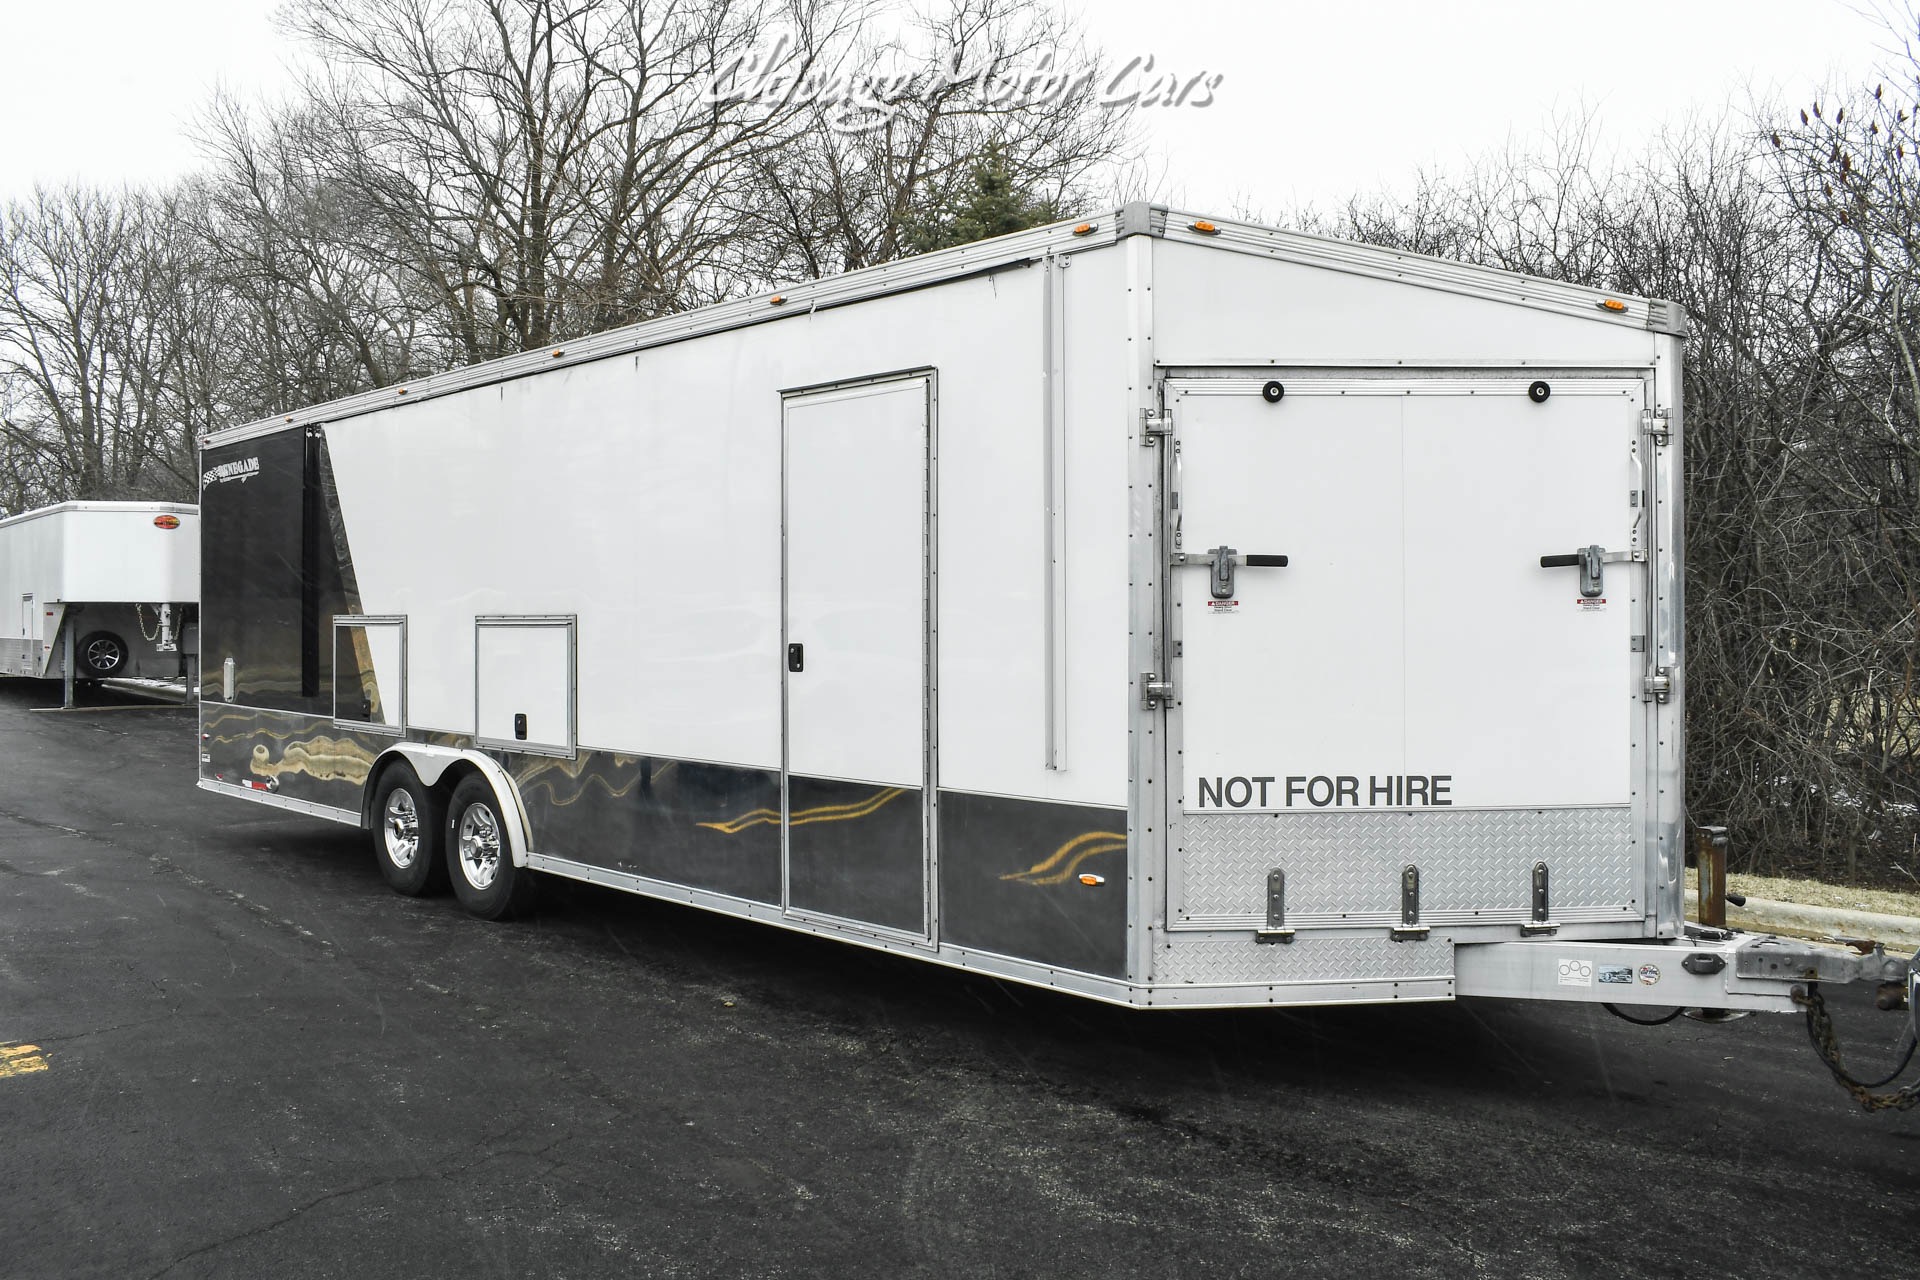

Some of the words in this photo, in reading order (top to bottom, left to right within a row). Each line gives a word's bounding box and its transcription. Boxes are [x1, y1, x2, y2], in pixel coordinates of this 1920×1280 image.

[1198, 776, 1276, 808] NOT
[1285, 775, 1360, 807] FOR
[1369, 775, 1452, 806] HIRE
